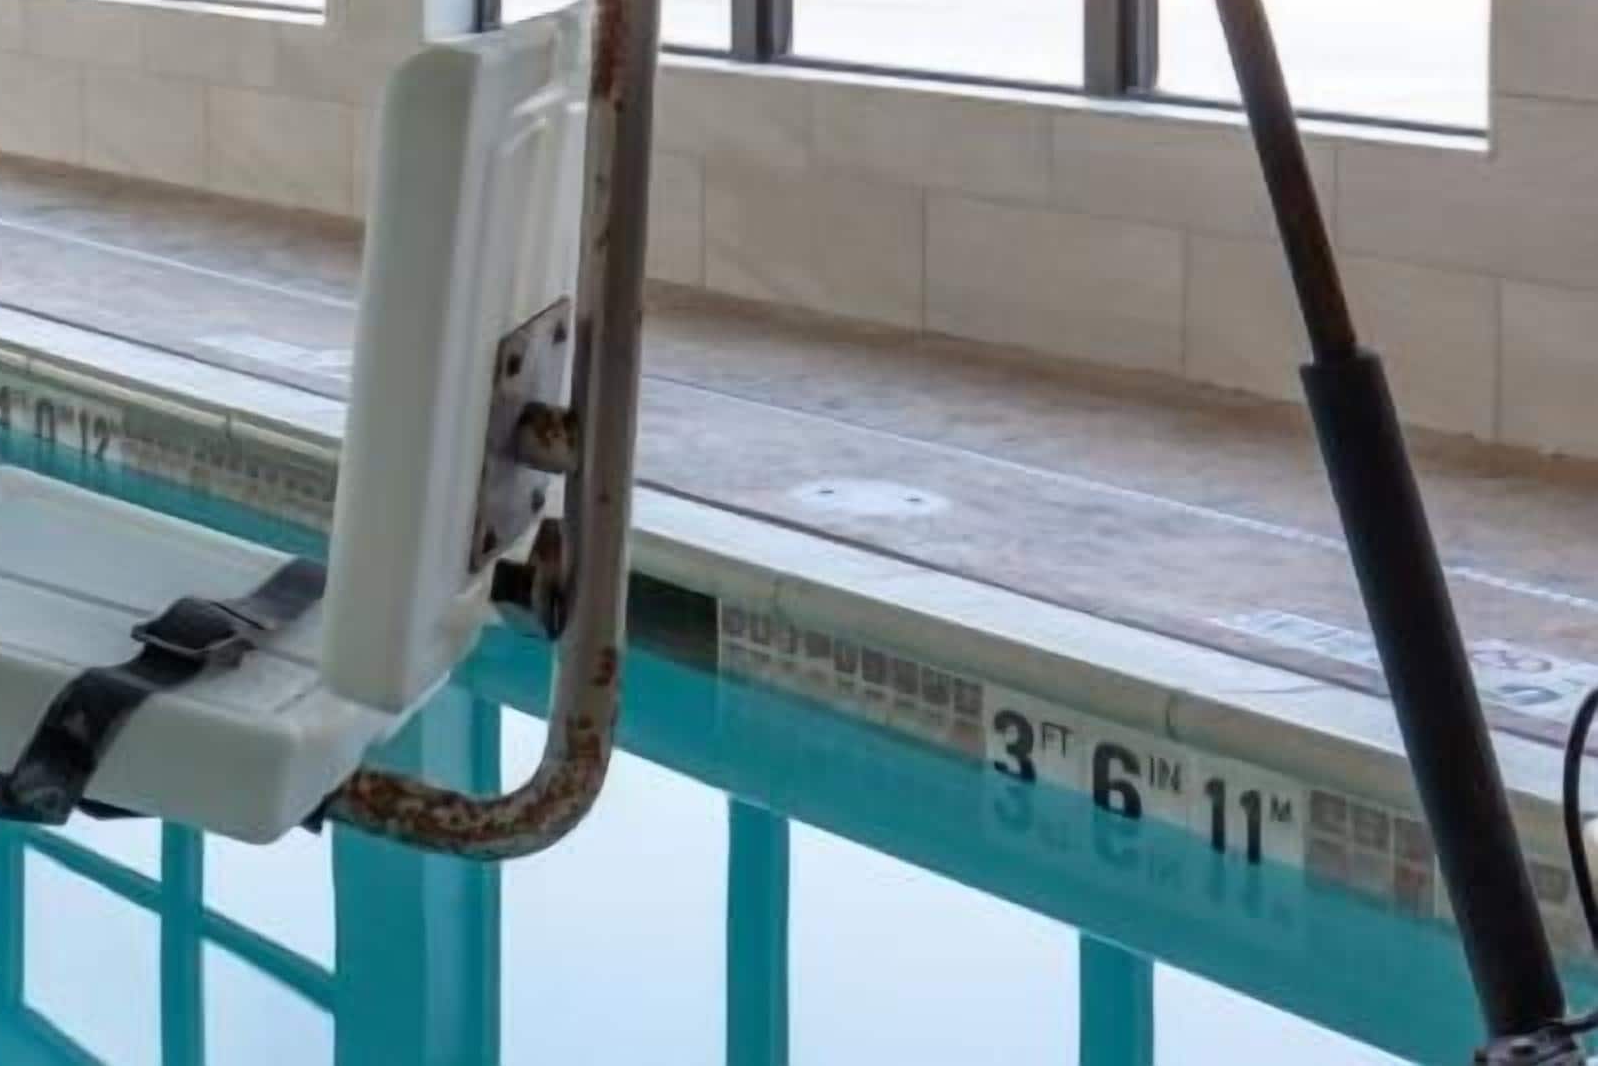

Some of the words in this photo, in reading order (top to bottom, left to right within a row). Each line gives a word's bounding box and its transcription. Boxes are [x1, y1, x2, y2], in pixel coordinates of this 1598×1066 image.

[994, 709, 1037, 784] 3
[1042, 721, 1072, 758] FT
[1092, 741, 1143, 821] 6
[1150, 754, 1183, 795] IN
[1270, 795, 1293, 823] M
